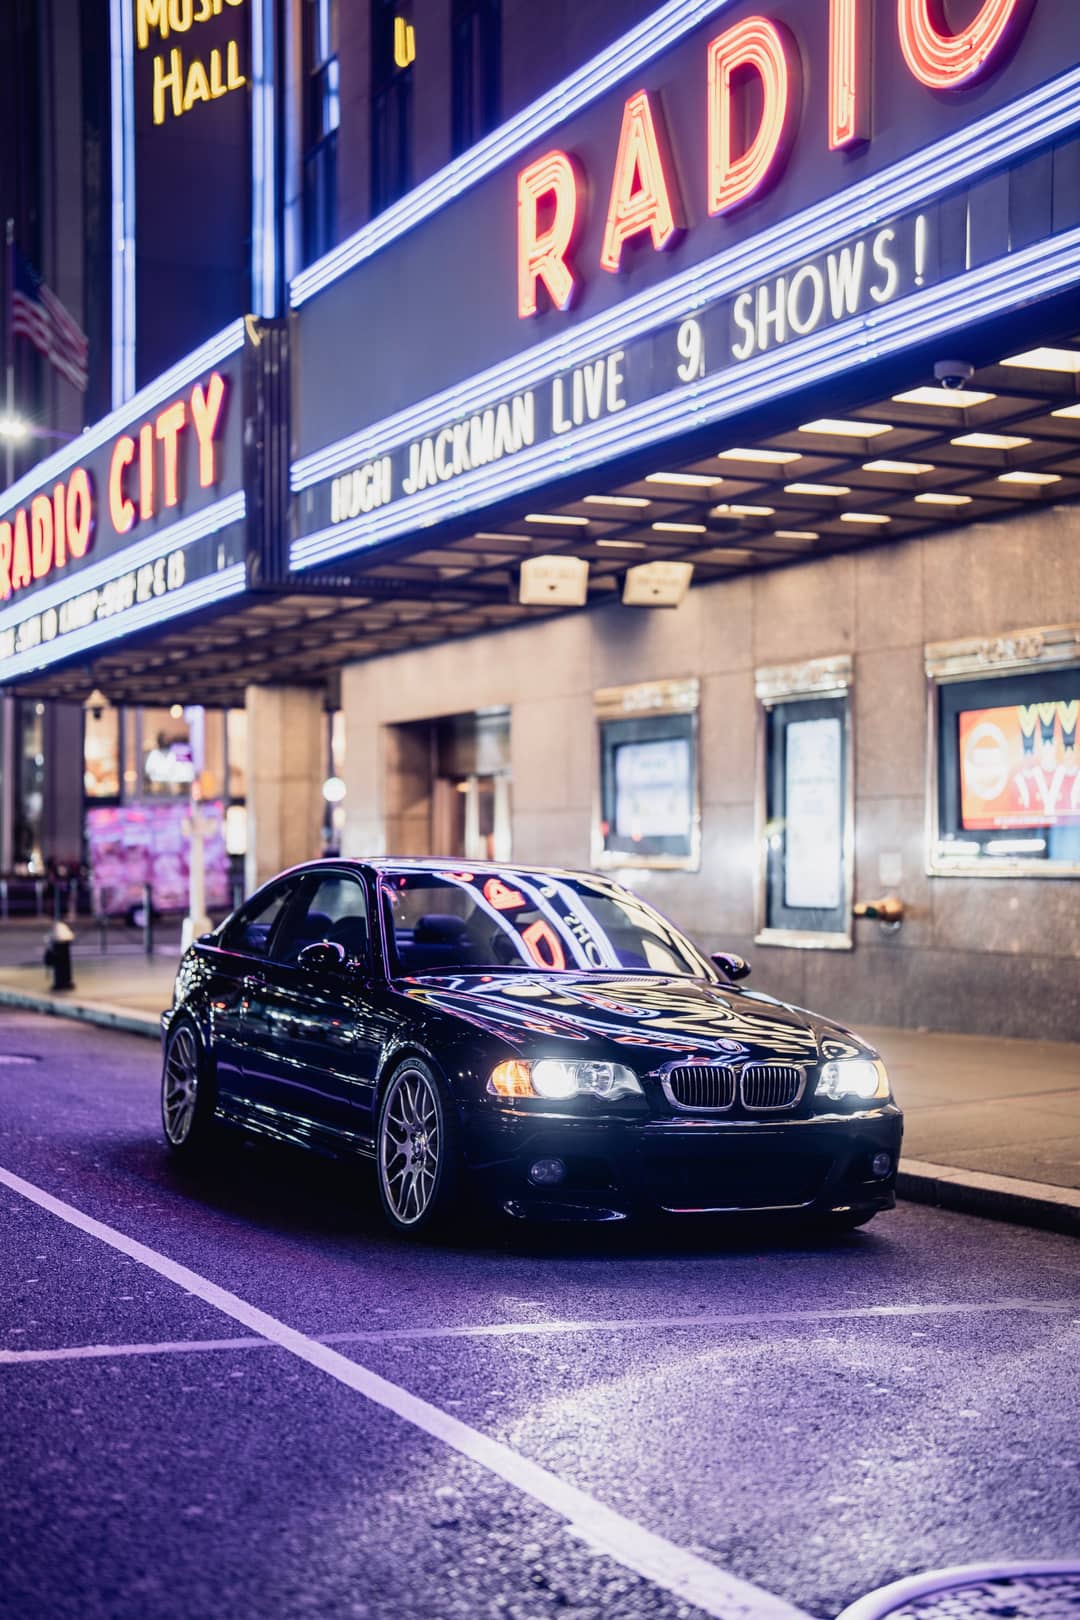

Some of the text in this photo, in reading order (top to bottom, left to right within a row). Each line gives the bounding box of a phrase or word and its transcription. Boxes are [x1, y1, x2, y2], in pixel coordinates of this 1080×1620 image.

[153, 40, 246, 125] HALL
[0, 371, 225, 601] RADIO CITY
[331, 456, 392, 524] HUGH
[402, 391, 535, 495] JACKMAN
[552, 350, 627, 435] LIVE
[676, 318, 703, 383] 9
